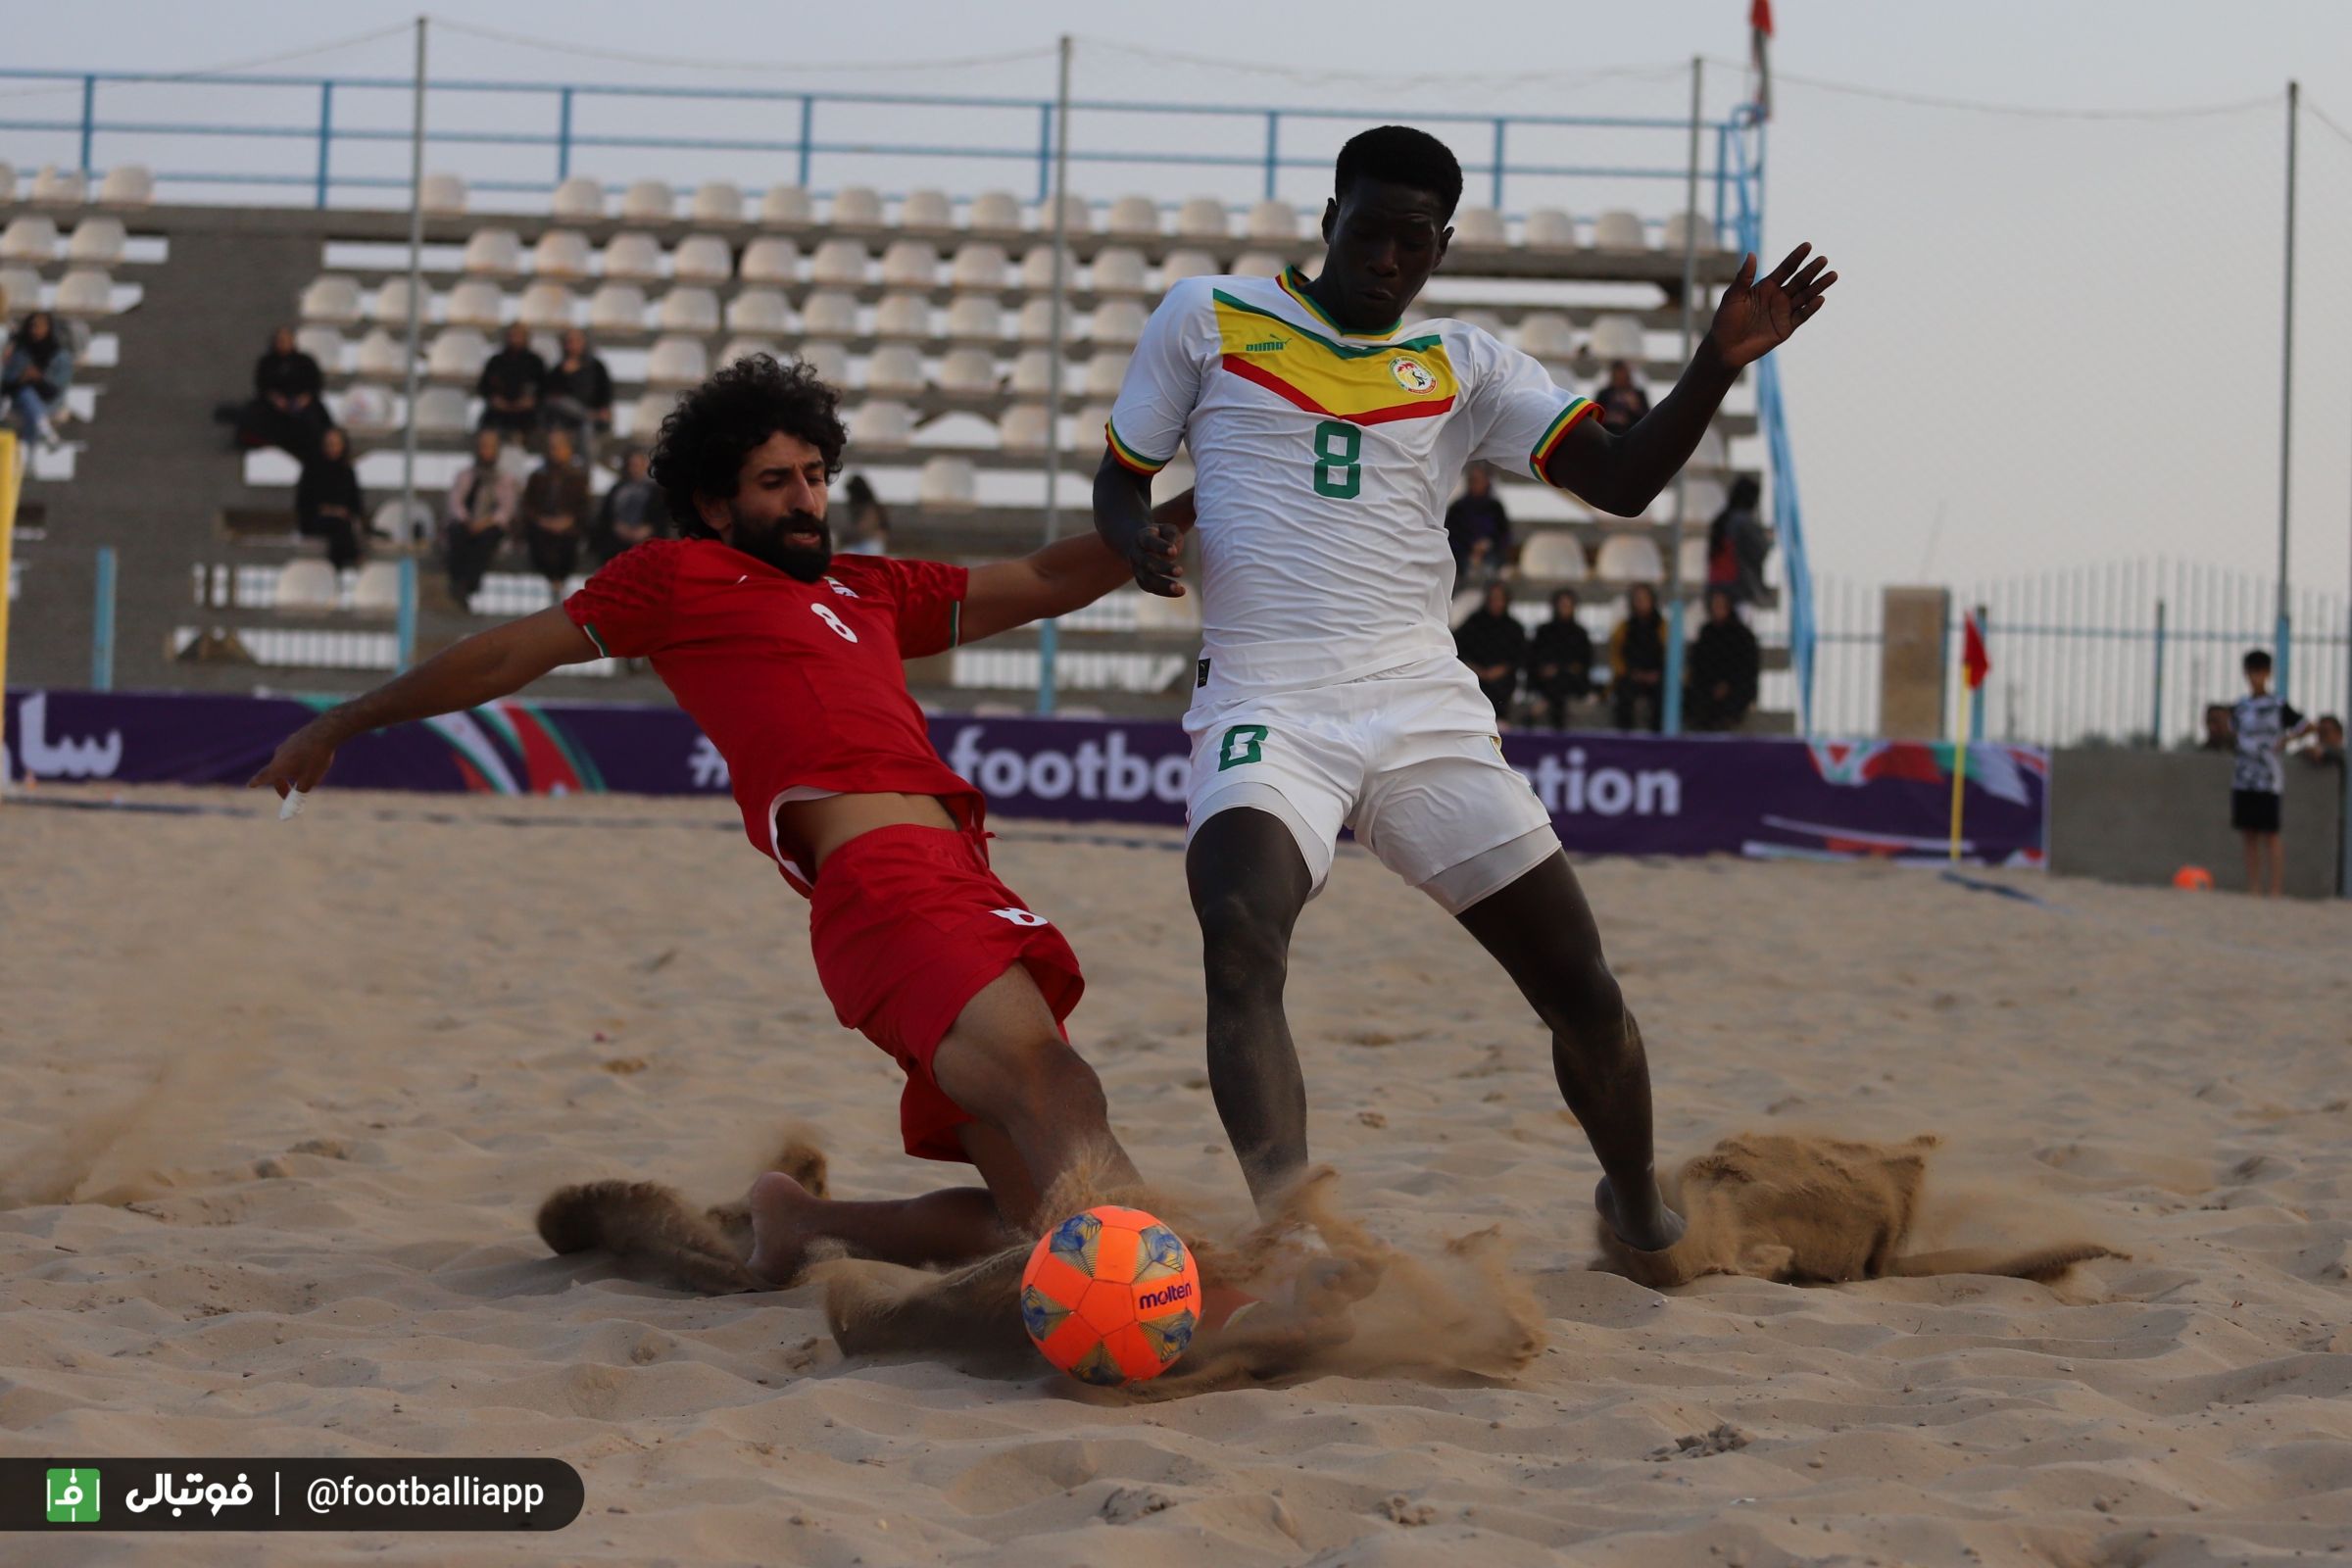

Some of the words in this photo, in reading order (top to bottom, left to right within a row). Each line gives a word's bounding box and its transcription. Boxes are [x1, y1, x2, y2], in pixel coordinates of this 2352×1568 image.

[1314, 420, 1361, 499] 8
[810, 603, 858, 643] 8
[950, 725, 1190, 802] footba
[1519, 746, 1683, 816] tion
[1140, 1282, 1192, 1310] molten
